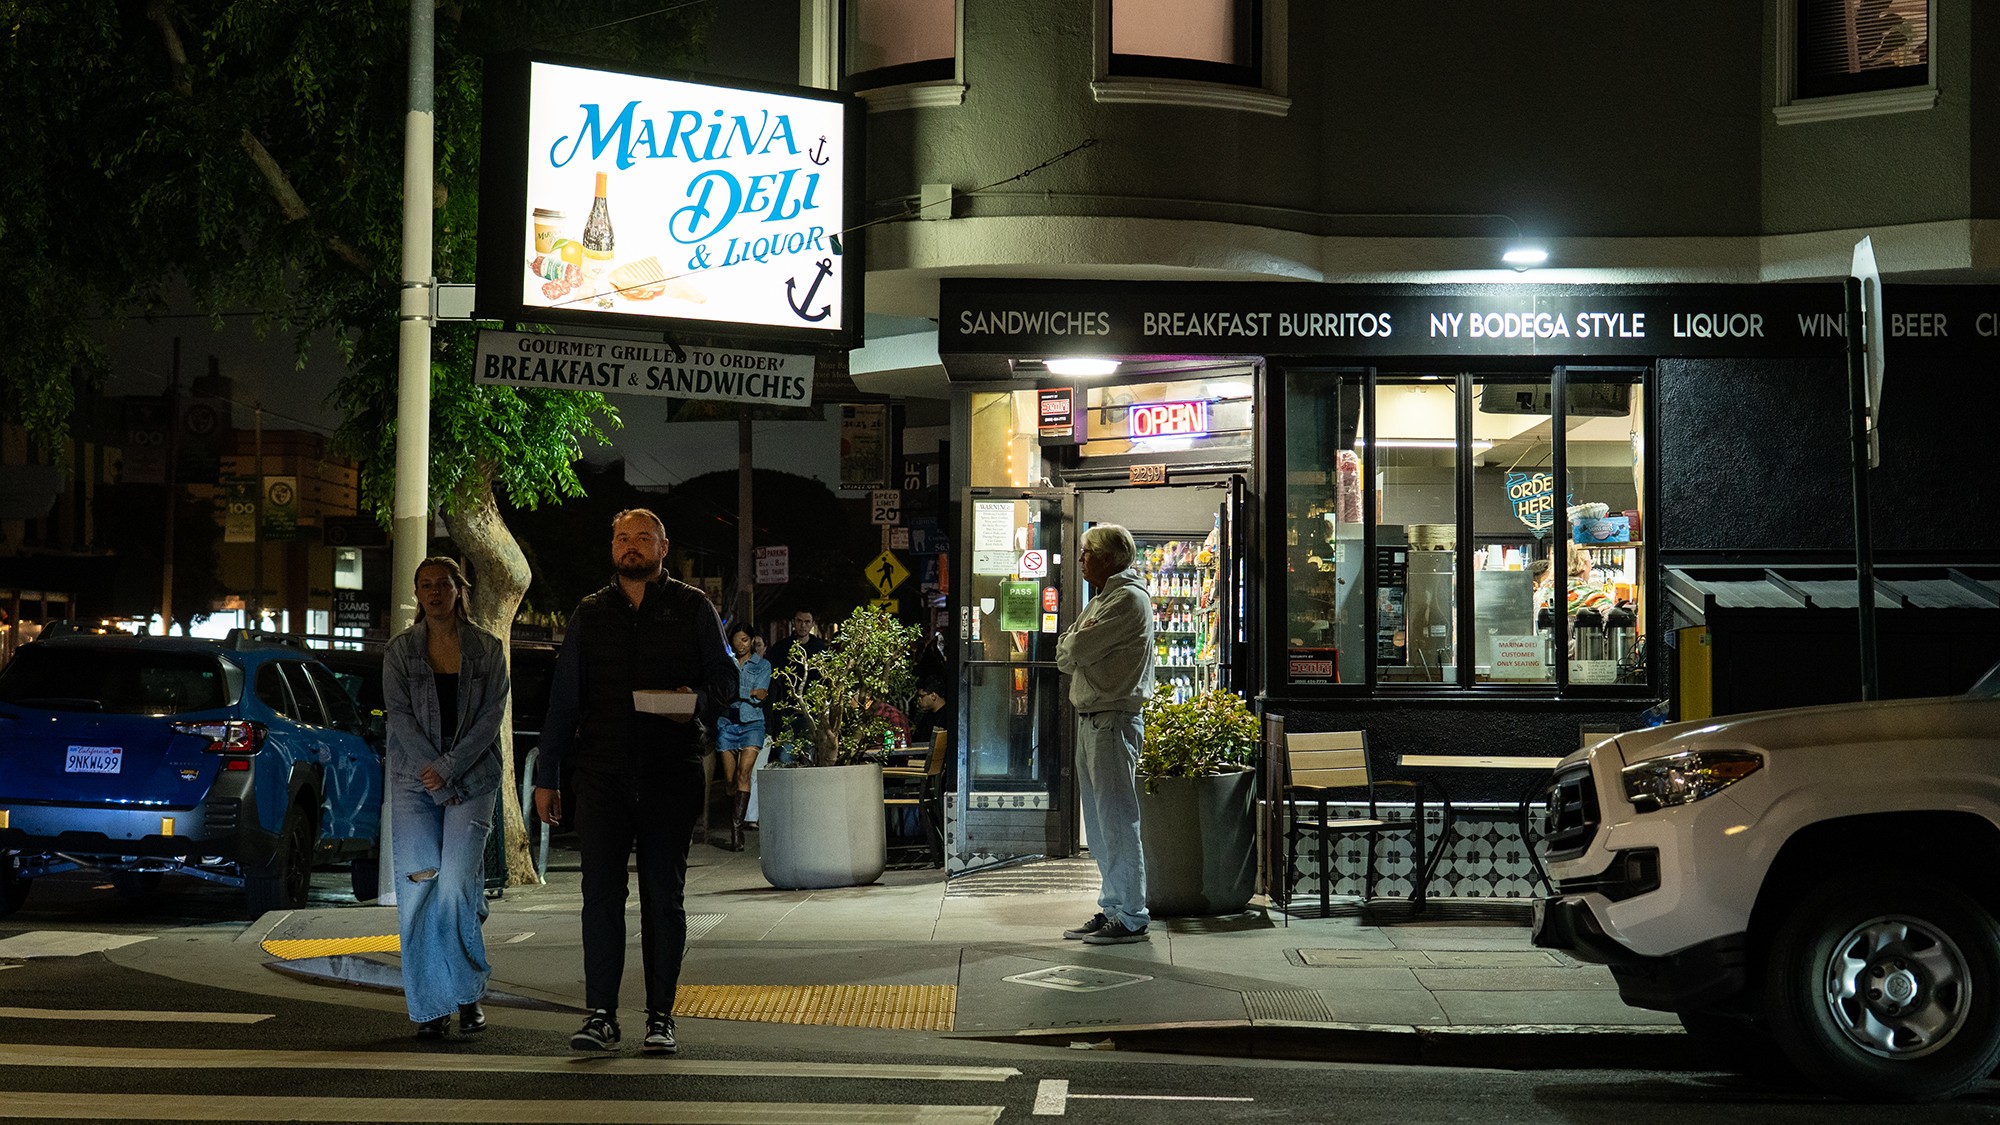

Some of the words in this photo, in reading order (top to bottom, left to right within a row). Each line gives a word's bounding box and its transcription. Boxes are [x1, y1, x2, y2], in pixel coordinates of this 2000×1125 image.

[688, 245, 711, 270] &
[722, 226, 825, 267] LIQUOR
[960, 310, 1110, 336] SANDWICHES
[1144, 312, 1272, 337] BREAKFAST
[1279, 312, 1393, 338] BURRITOS
[1430, 313, 1463, 338] NY
[1470, 312, 1570, 338] BODEGA
[1576, 312, 1646, 338] STYLE
[1673, 313, 1765, 339] LIQUOR
[1798, 313, 1848, 337] WIN
[1892, 313, 1948, 337] BEER
[518, 338, 606, 357] GOURMET
[693, 351, 715, 365] TO
[484, 354, 624, 388] BREAKFAST
[628, 373, 639, 386] &
[646, 366, 806, 400] SANDWICHES
[1134, 401, 1203, 436] OPEN
[1133, 466, 1160, 482] 2299
[1510, 476, 1553, 499] ORDE
[228, 503, 255, 514] 100
[875, 507, 897, 521] 20
[767, 549, 787, 557] PARKING
[338, 592, 355, 601] EYE
[1010, 588, 1032, 596] PASS
[338, 602, 370, 612] EXAMS
[338, 612, 370, 620] AVAILABLE
[1290, 661, 1332, 676] Sentry
[78, 747, 110, 756] California
[68, 755, 119, 771] 9NKW499
